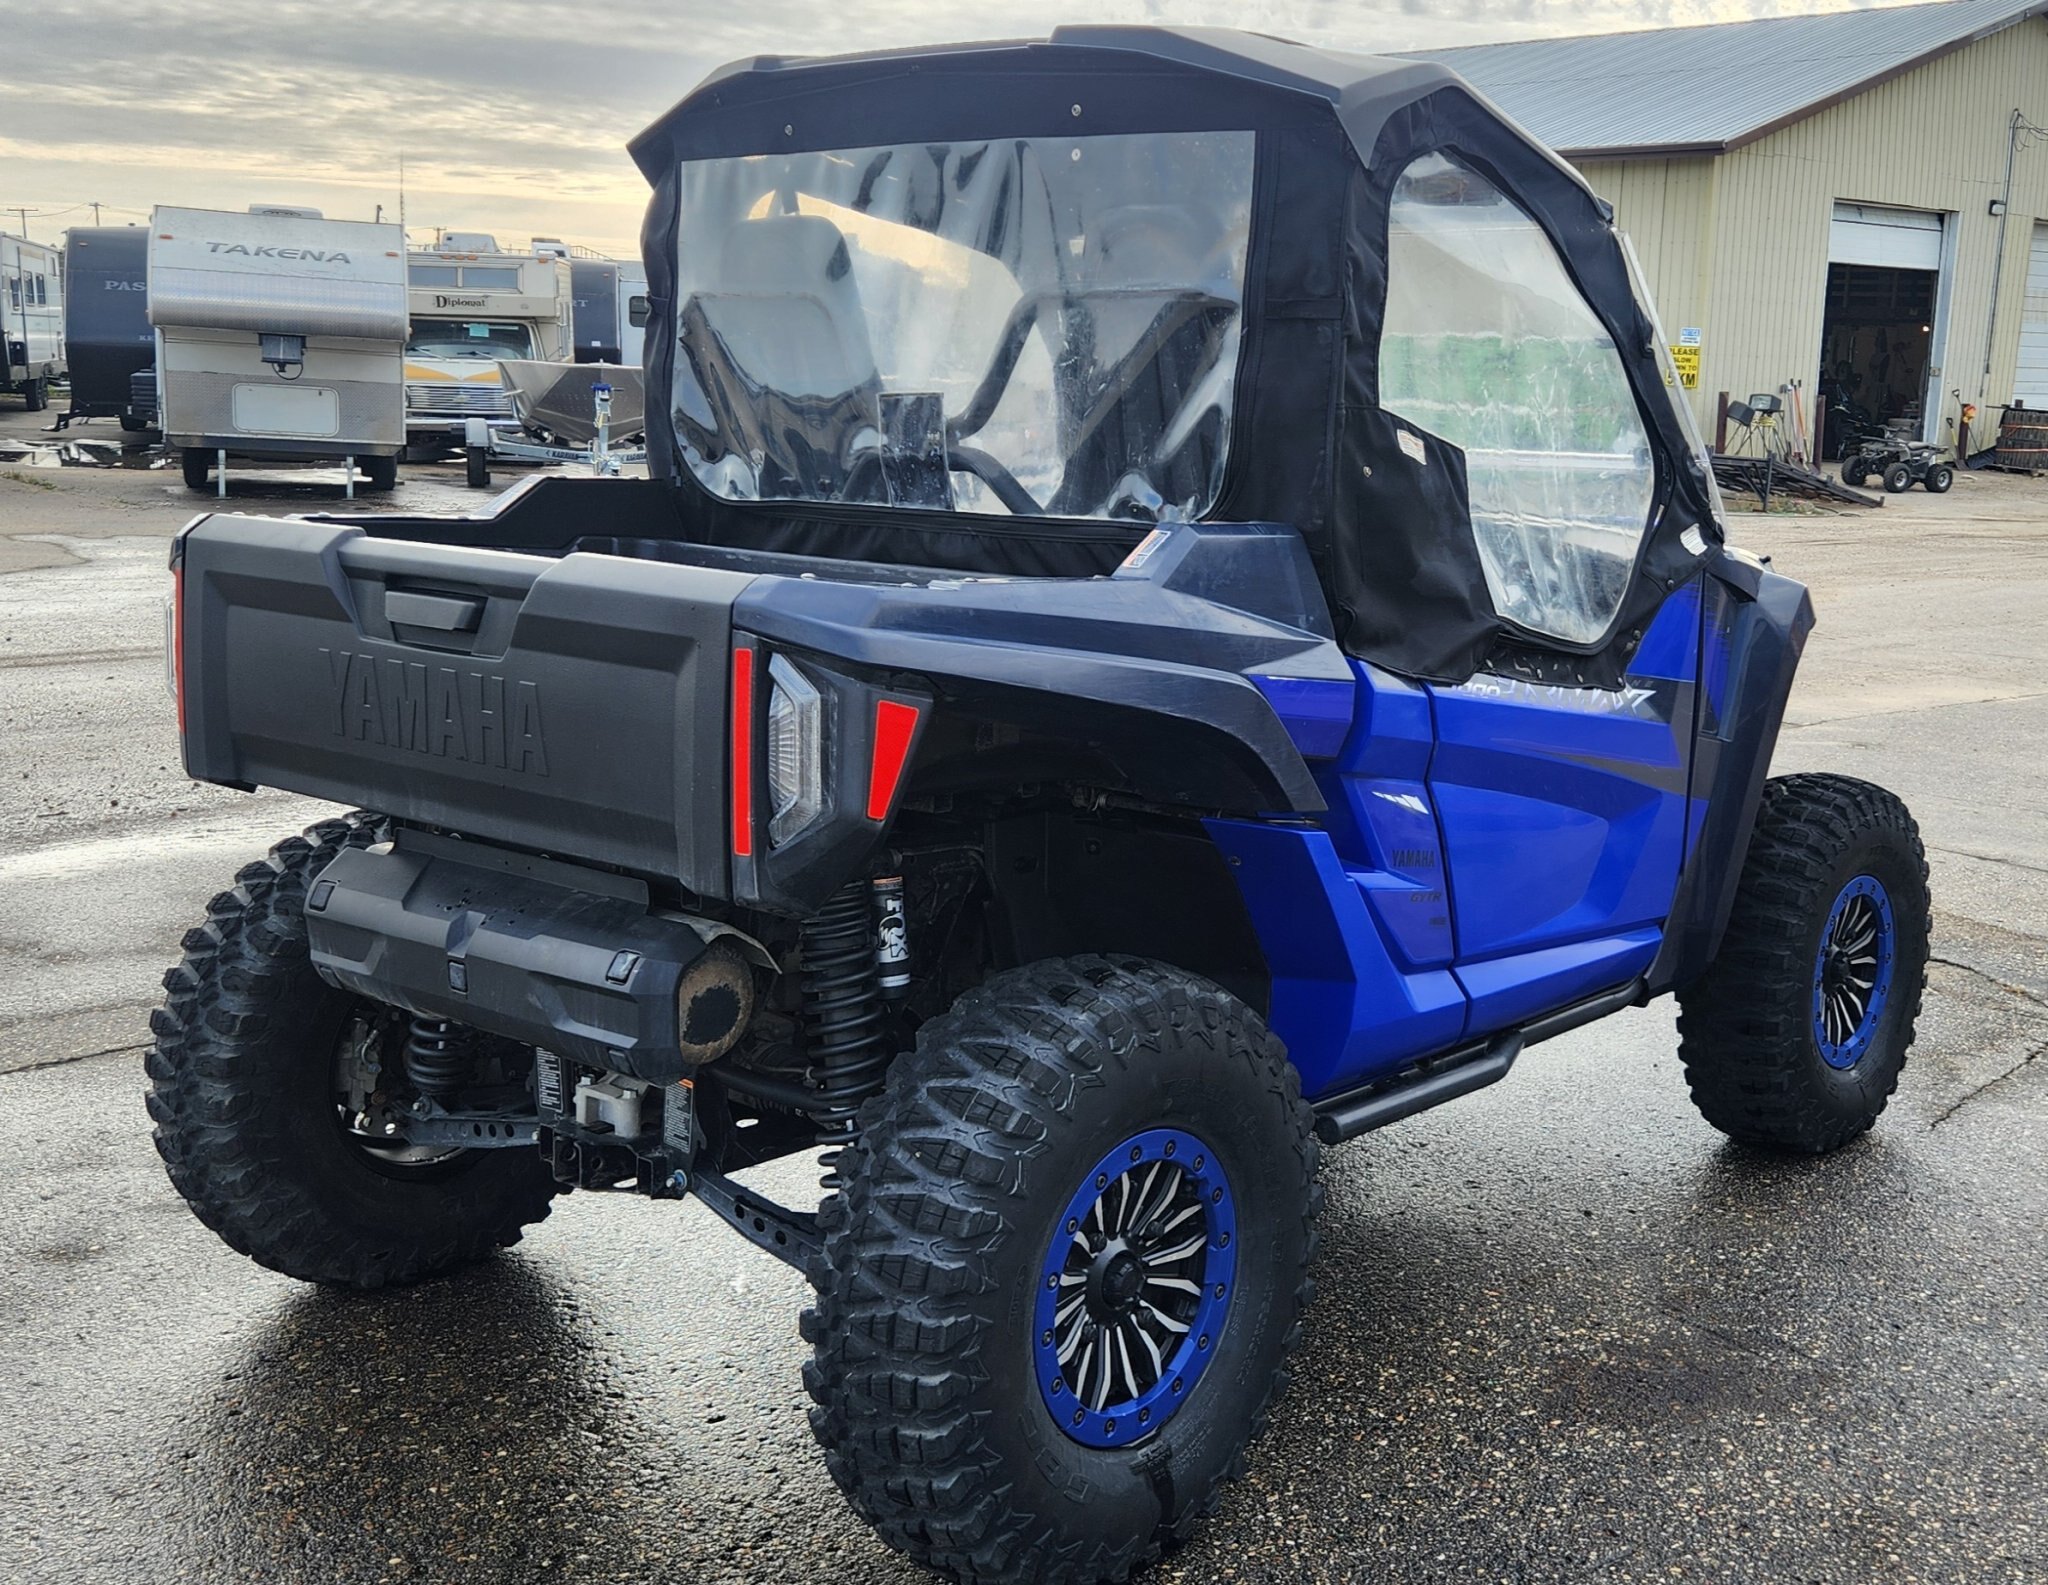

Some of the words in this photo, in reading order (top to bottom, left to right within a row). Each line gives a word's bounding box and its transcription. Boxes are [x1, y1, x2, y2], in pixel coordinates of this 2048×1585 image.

[206, 241, 352, 264] TAKENA
[435, 294, 486, 308] Diplomat
[318, 647, 550, 777] YAMAHA
[1392, 848, 1435, 868] YAMAHA
